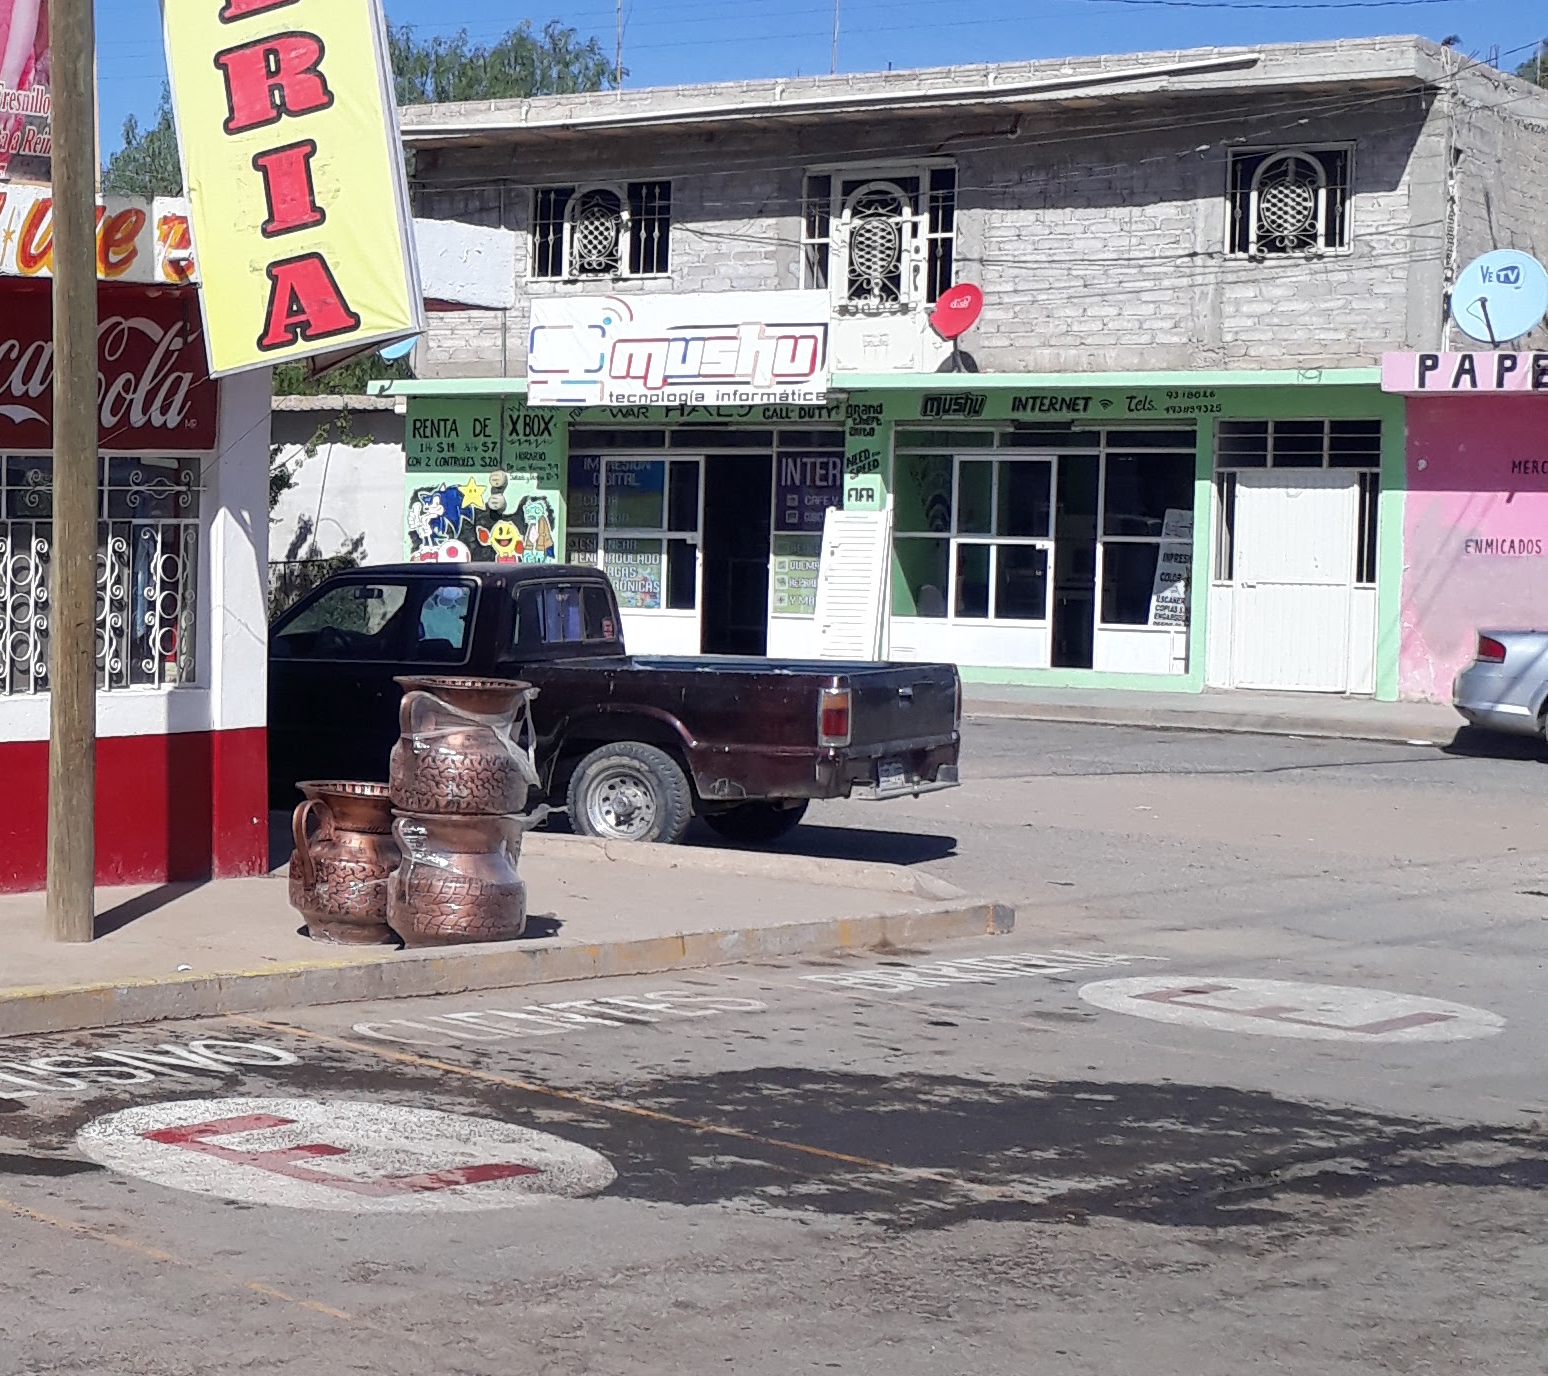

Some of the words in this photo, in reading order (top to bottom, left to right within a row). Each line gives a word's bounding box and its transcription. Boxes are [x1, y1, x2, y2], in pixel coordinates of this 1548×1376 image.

[10, 133, 21, 153] a
[1496, 266, 1520, 285] TV
[609, 390, 705, 405] tecnología
[1011, 396, 1091, 412] INTERNET
[763, 407, 791, 419] CALL
[412, 418, 459, 439] RENTA
[473, 418, 491, 438] DE
[407, 457, 422, 467] CON
[425, 456, 432, 467] 2
[847, 449, 870, 467] NEED
[850, 458, 879, 480] SPEED
[593, 472, 641, 485] DGITAL
[848, 488, 874, 502] FIFA
[1465, 538, 1542, 555] ENMICADOS
